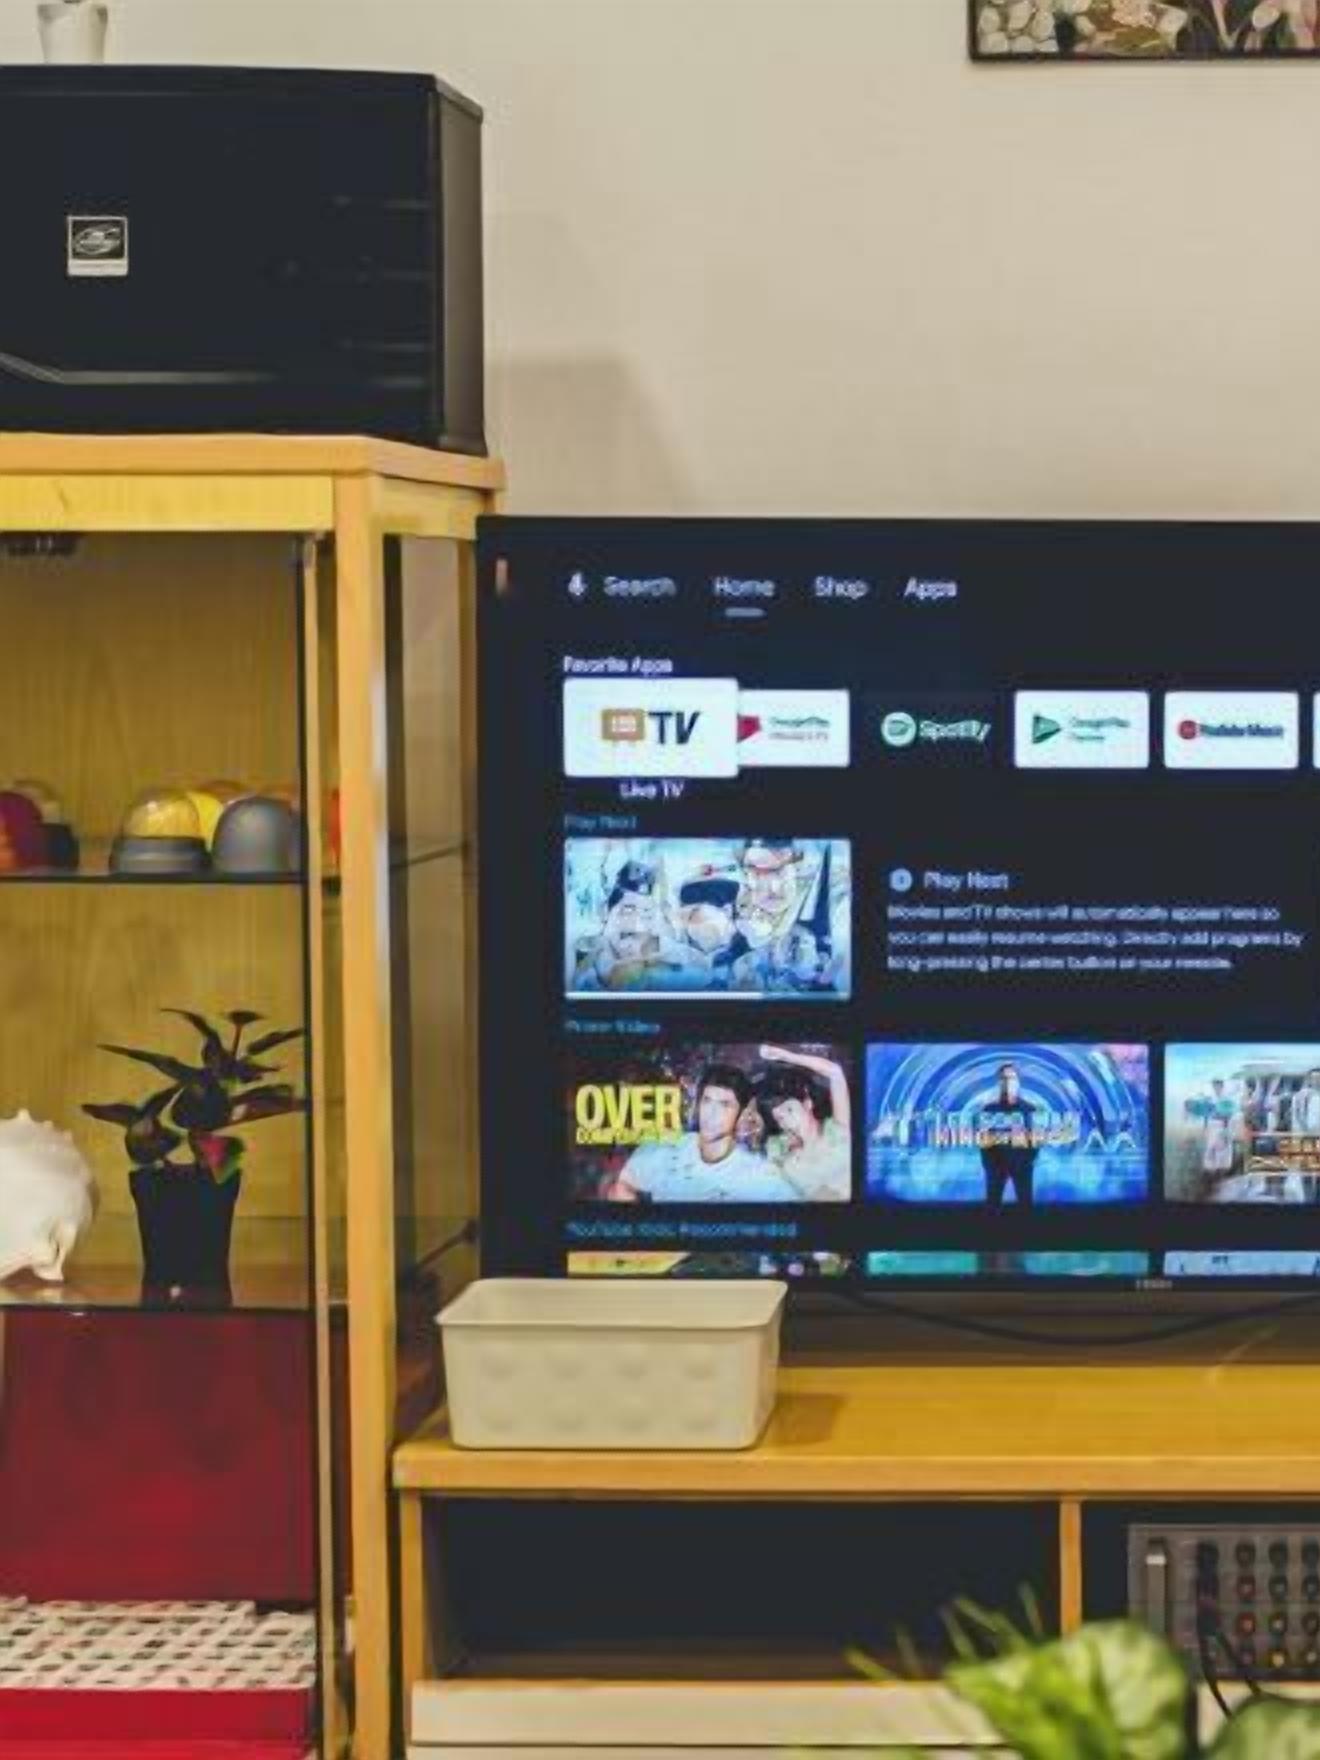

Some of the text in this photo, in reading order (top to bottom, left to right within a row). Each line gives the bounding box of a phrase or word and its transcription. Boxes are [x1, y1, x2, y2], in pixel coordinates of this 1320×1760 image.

[603, 576, 677, 597] Search
[714, 576, 775, 597] Home
[814, 576, 870, 600] Shop
[903, 576, 957, 601] Apps
[631, 655, 674, 677] Apps
[647, 710, 701, 746] TV
[918, 719, 992, 743] Spotify
[618, 780, 686, 799] Live TV
[923, 870, 964, 892] Play
[575, 1082, 683, 1130] OVER
